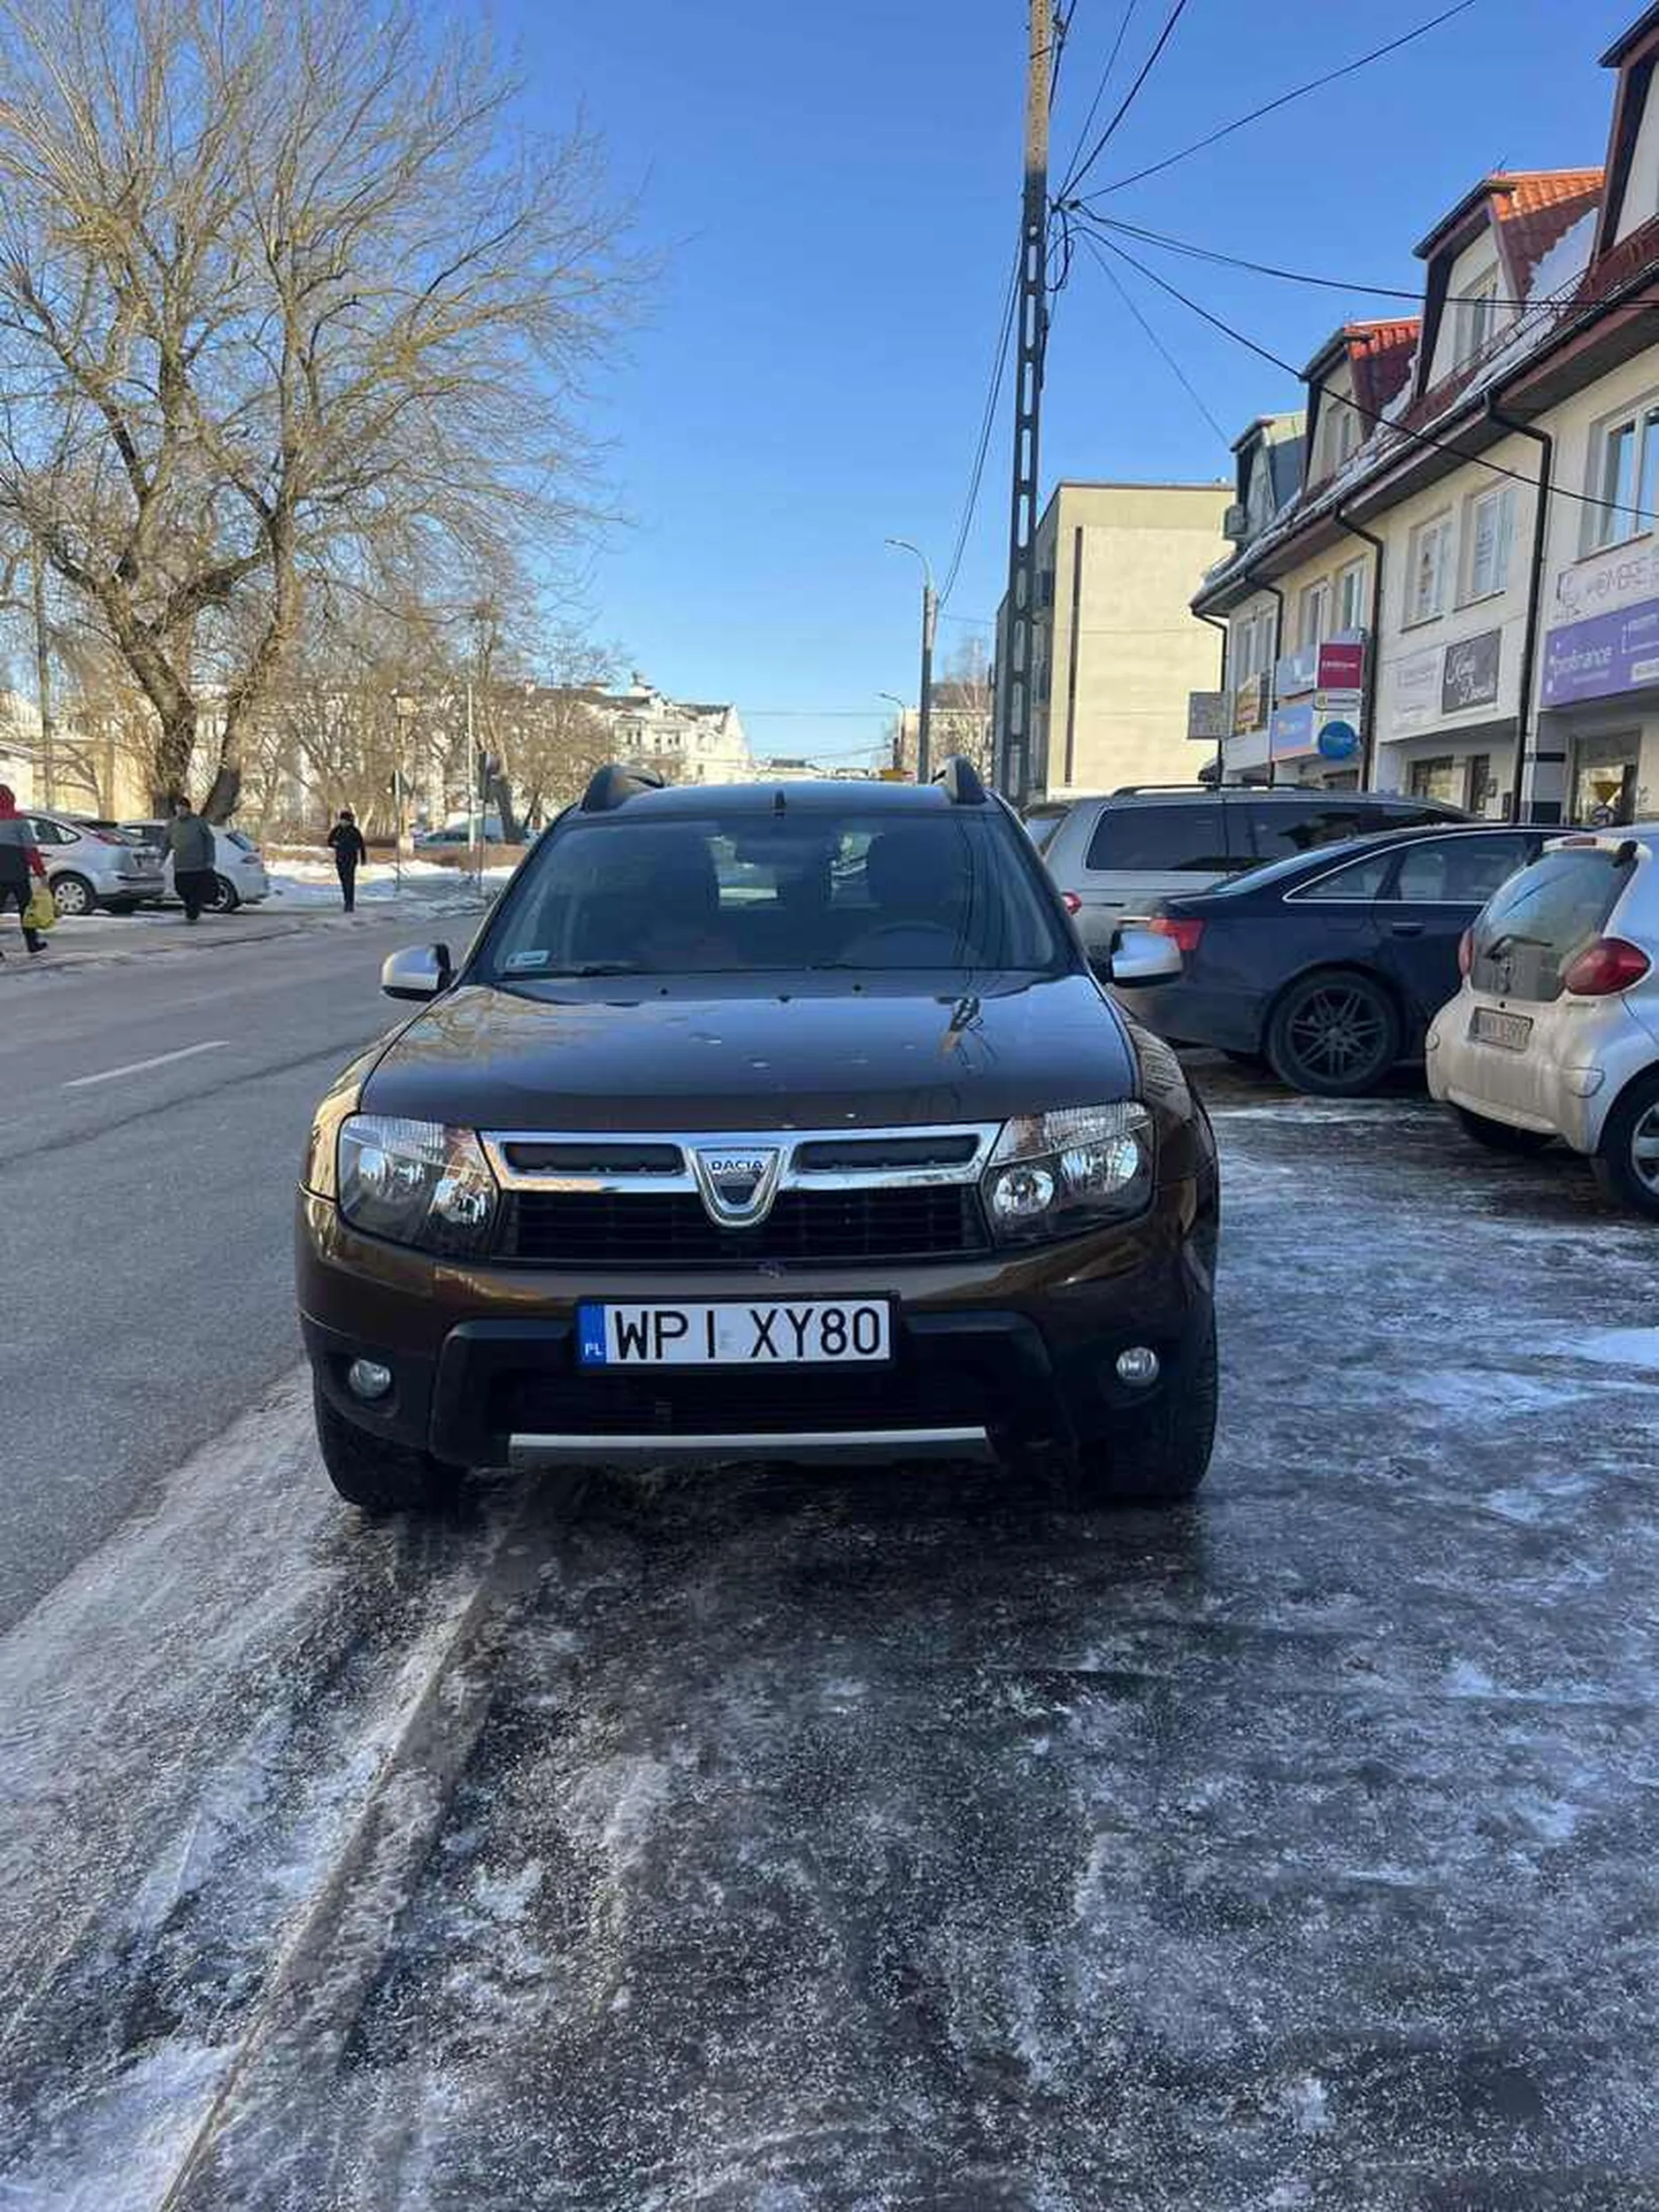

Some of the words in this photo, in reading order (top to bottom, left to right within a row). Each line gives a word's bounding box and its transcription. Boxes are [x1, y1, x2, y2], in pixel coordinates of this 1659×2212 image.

[711, 1160, 764, 1171] DACIA
[614, 1310, 716, 1360] WPI
[750, 1307, 880, 1358] XY80
[585, 1343, 603, 1356] PL
